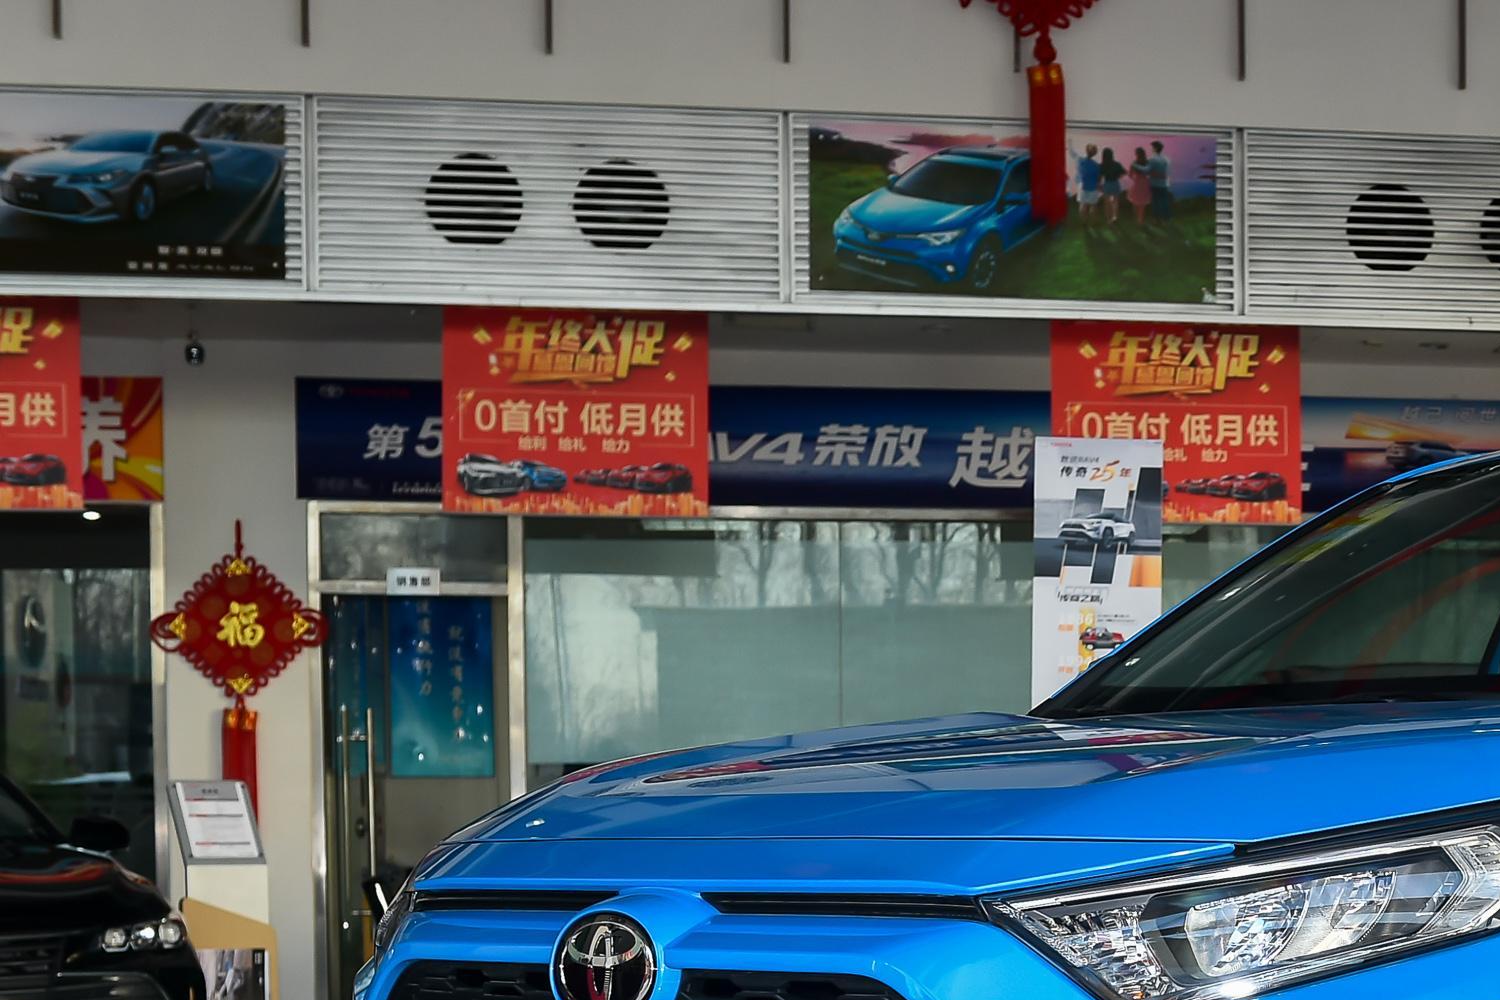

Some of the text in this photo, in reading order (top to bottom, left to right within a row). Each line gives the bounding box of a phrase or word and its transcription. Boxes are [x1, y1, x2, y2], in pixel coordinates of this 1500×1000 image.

[496, 316, 666, 379] 年终大促
[1102, 331, 1260, 390] 年终大促
[475, 400, 685, 437] 0首付 低月供
[1180, 414, 1279, 446] 低月供
[216, 600, 265, 648] 福
